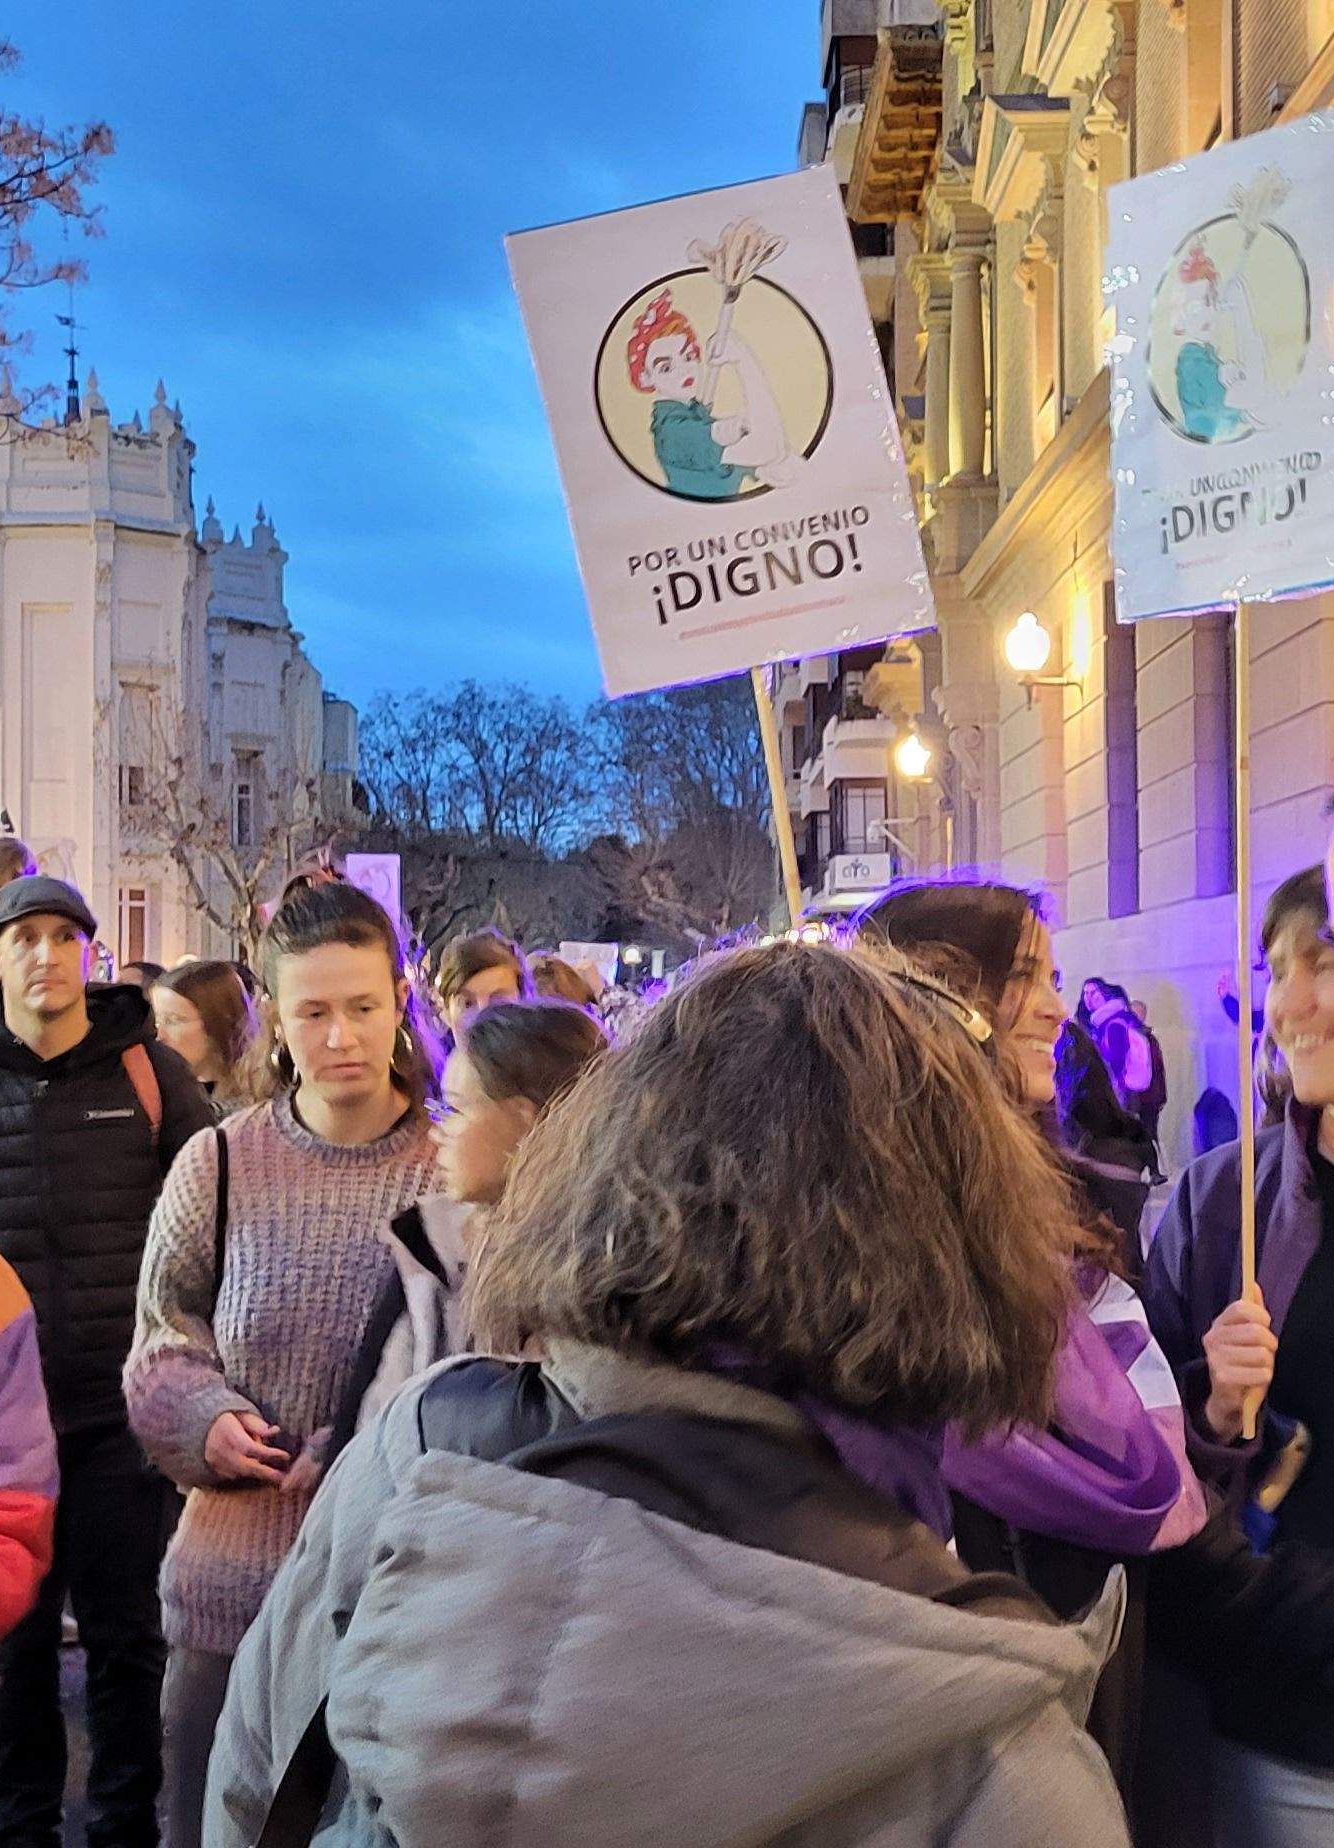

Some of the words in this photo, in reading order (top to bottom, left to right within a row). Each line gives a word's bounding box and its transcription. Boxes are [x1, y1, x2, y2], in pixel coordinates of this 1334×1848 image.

[628, 547, 682, 577] POR
[688, 535, 727, 562] UN
[733, 505, 870, 551] CONVENIO
[652, 533, 863, 626] ¡DIGNO!
